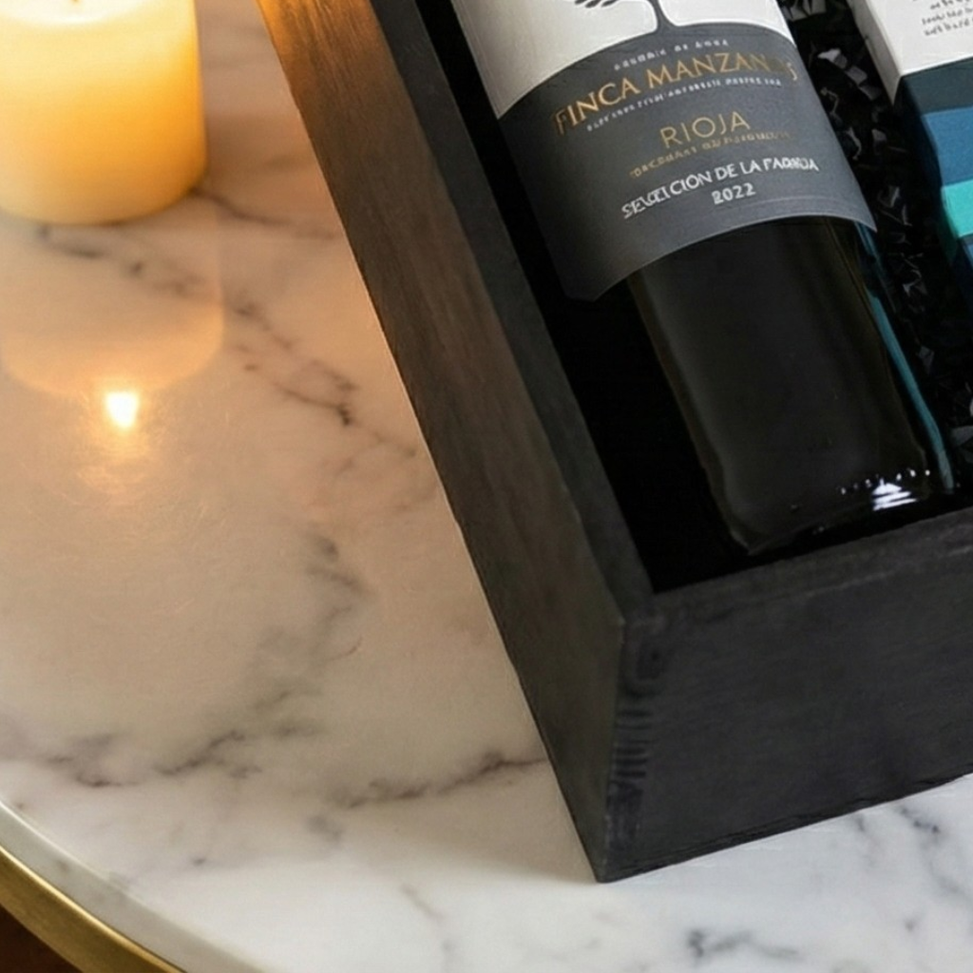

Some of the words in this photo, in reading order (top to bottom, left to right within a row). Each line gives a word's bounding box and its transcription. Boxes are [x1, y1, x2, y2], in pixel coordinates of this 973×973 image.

[554, 77, 641, 136] FINCA
[646, 51, 799, 89] MANZANS
[659, 110, 751, 149] RIOJA
[713, 163, 739, 182] DE
[739, 159, 762, 176] LA
[710, 181, 757, 206] 2022
